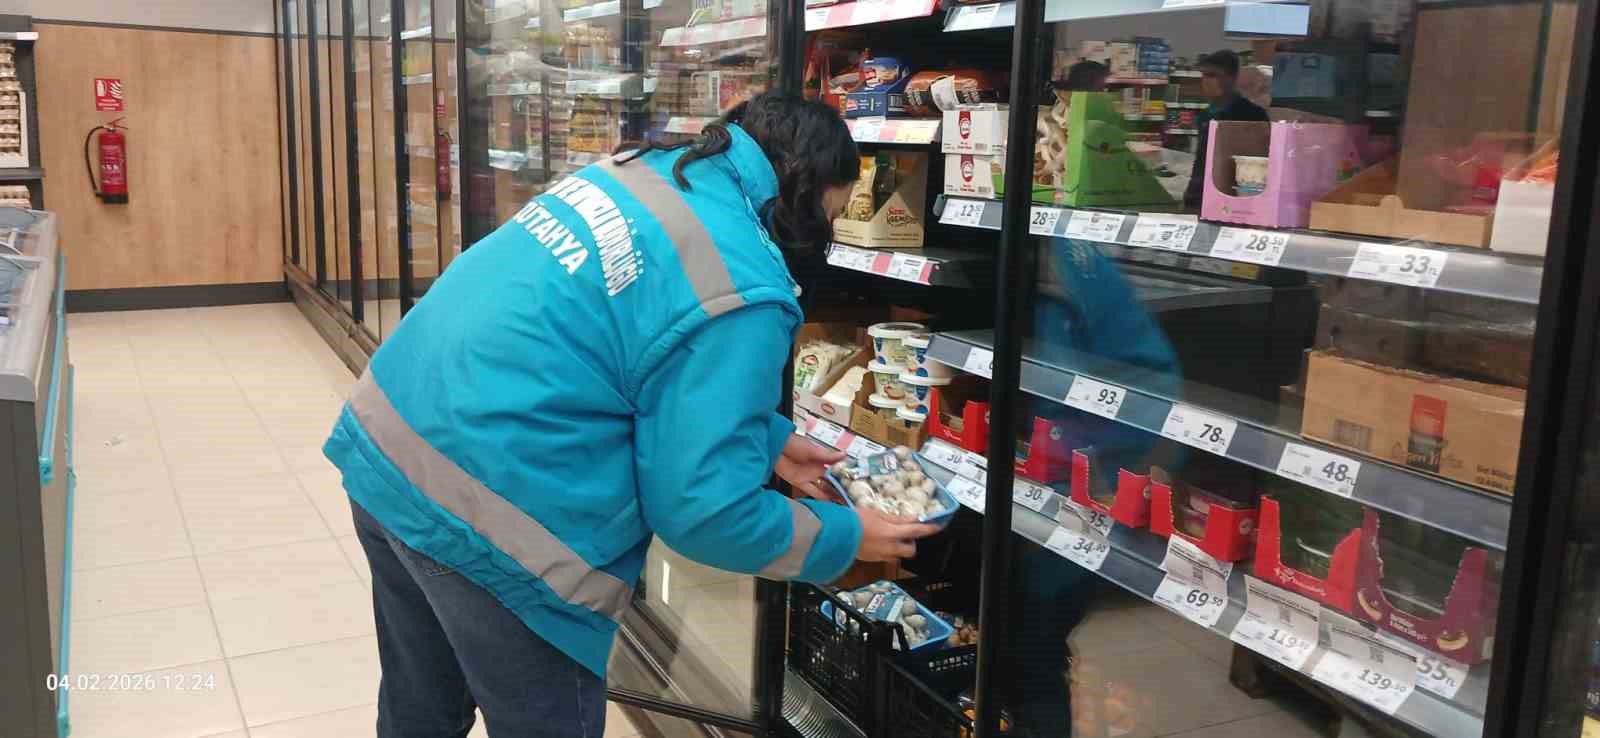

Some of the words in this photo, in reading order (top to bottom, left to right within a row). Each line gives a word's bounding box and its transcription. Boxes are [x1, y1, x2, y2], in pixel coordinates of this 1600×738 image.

[1032, 211, 1049, 225] 28
[513, 200, 589, 275] ÜTAHYA
[1246, 233, 1268, 251] 28
[1400, 254, 1430, 274] 33
[1097, 388, 1117, 405] 93
[1200, 423, 1223, 442] 78
[1322, 461, 1349, 482] 48
[1024, 485, 1042, 501] 30
[1186, 588, 1210, 607] 69
[1417, 657, 1449, 681] 55
[1357, 668, 1392, 690] 139
